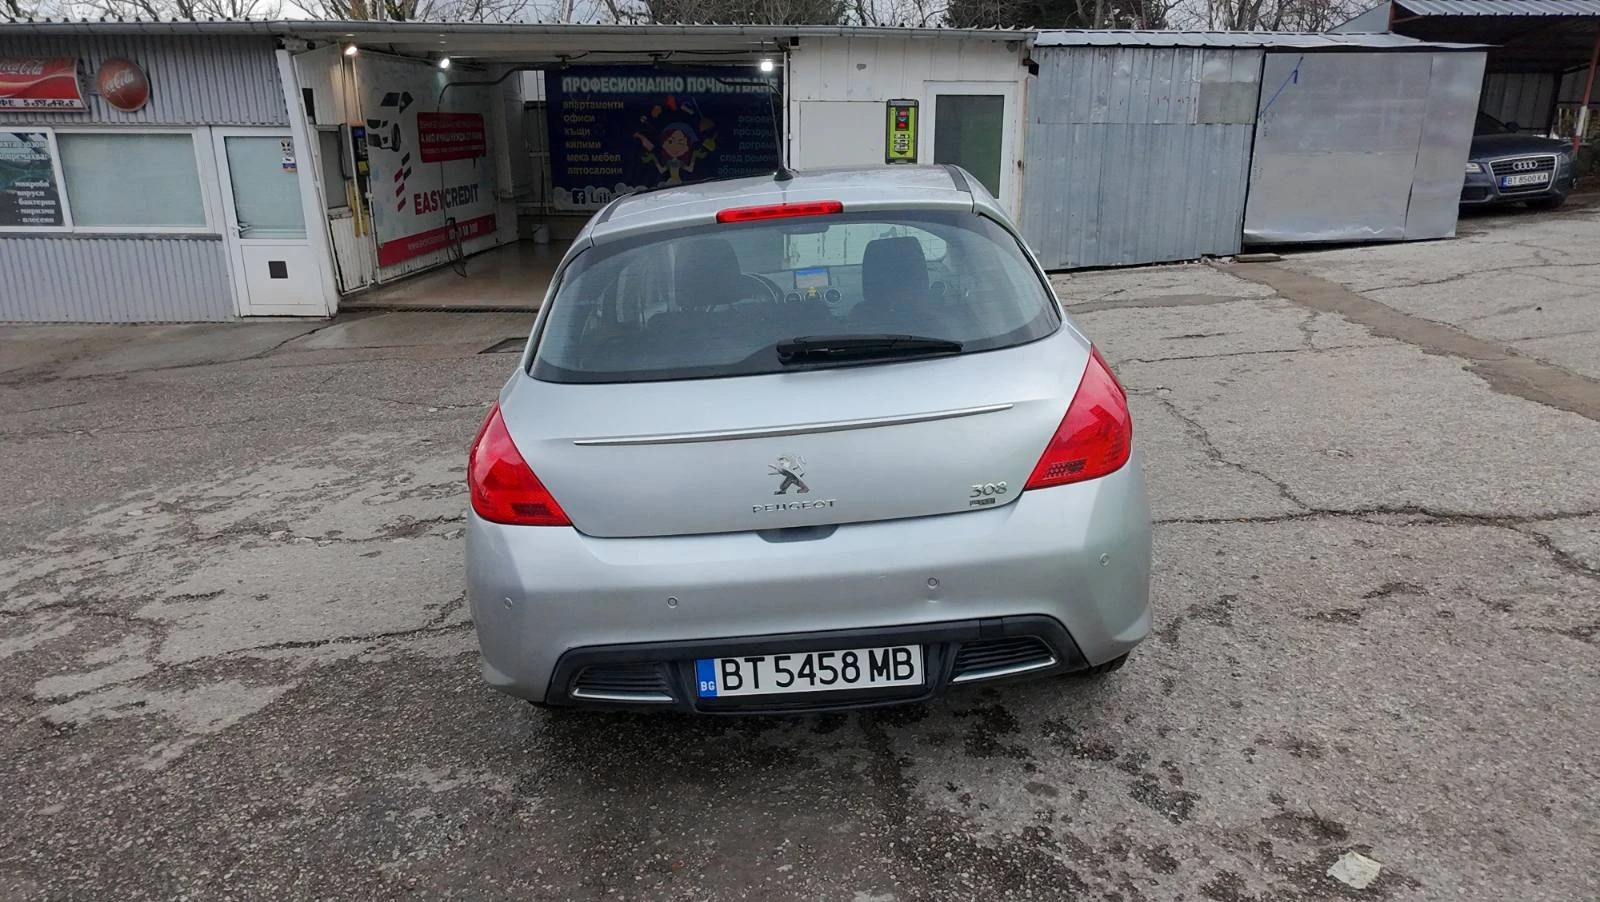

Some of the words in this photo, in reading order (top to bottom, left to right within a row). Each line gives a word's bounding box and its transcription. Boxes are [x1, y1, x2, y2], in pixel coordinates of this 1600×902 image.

[562, 77, 684, 93] ПРОФЕСИОНАЛНО
[0, 99, 15, 107] ФЕ
[563, 114, 595, 123] офиси
[969, 481, 1007, 498] 308
[752, 499, 837, 513] PEUGEOT
[720, 657, 765, 690] BT
[774, 651, 861, 688] 5458
[868, 647, 914, 682] MB
[701, 681, 715, 692] BG
